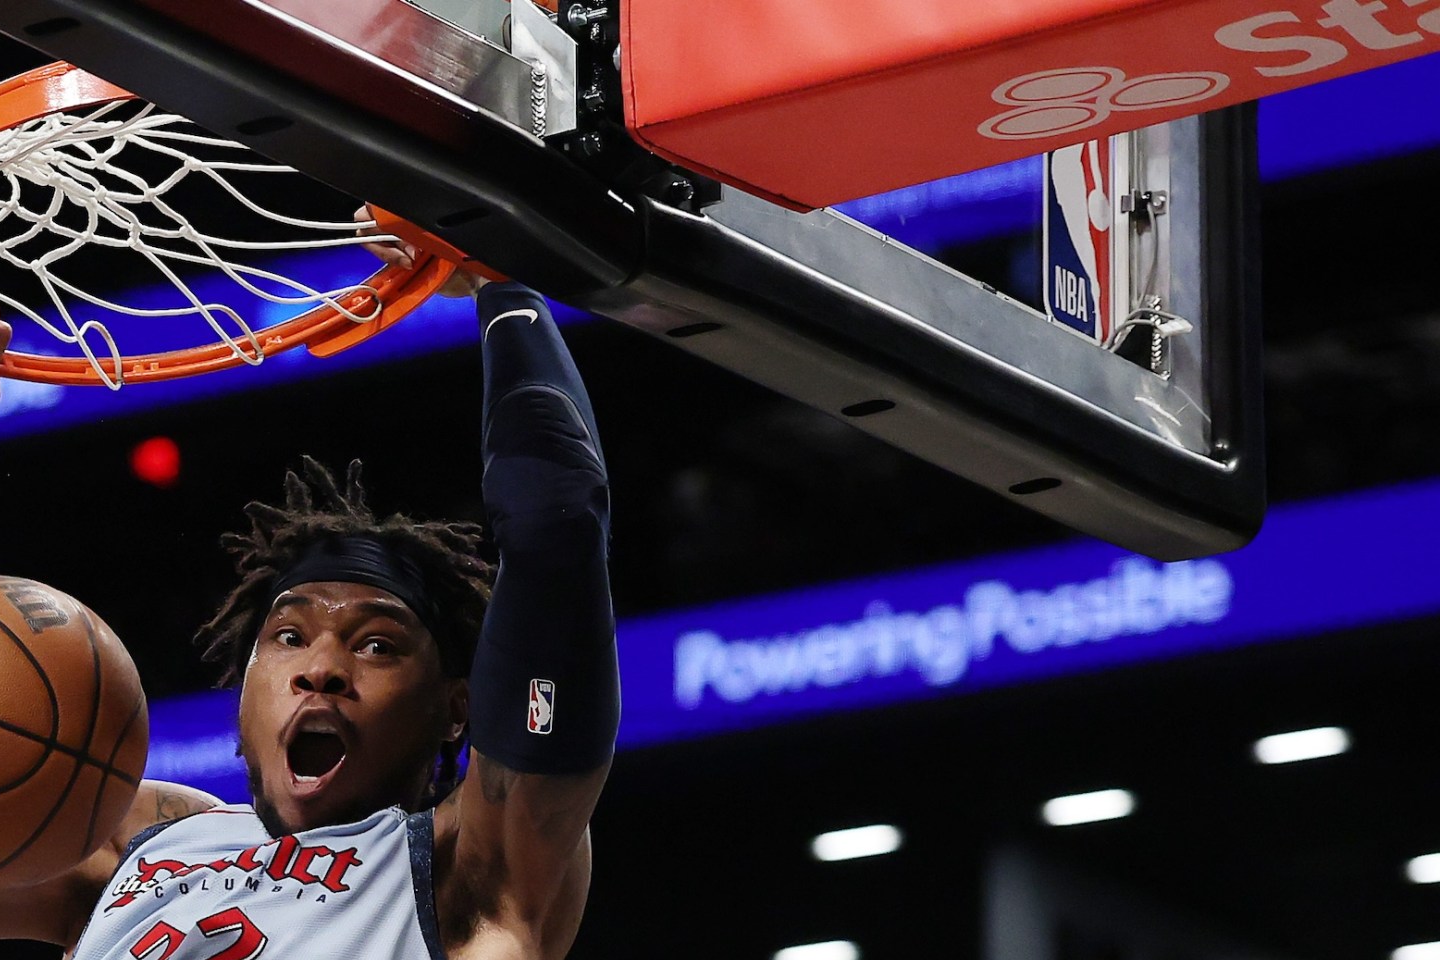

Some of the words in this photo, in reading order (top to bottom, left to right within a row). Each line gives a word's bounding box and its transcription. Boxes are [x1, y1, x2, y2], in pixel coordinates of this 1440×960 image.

[1214, 0, 1440, 77] St
[1054, 265, 1089, 323] NBA
[154, 876, 328, 904] COLUMBIA
